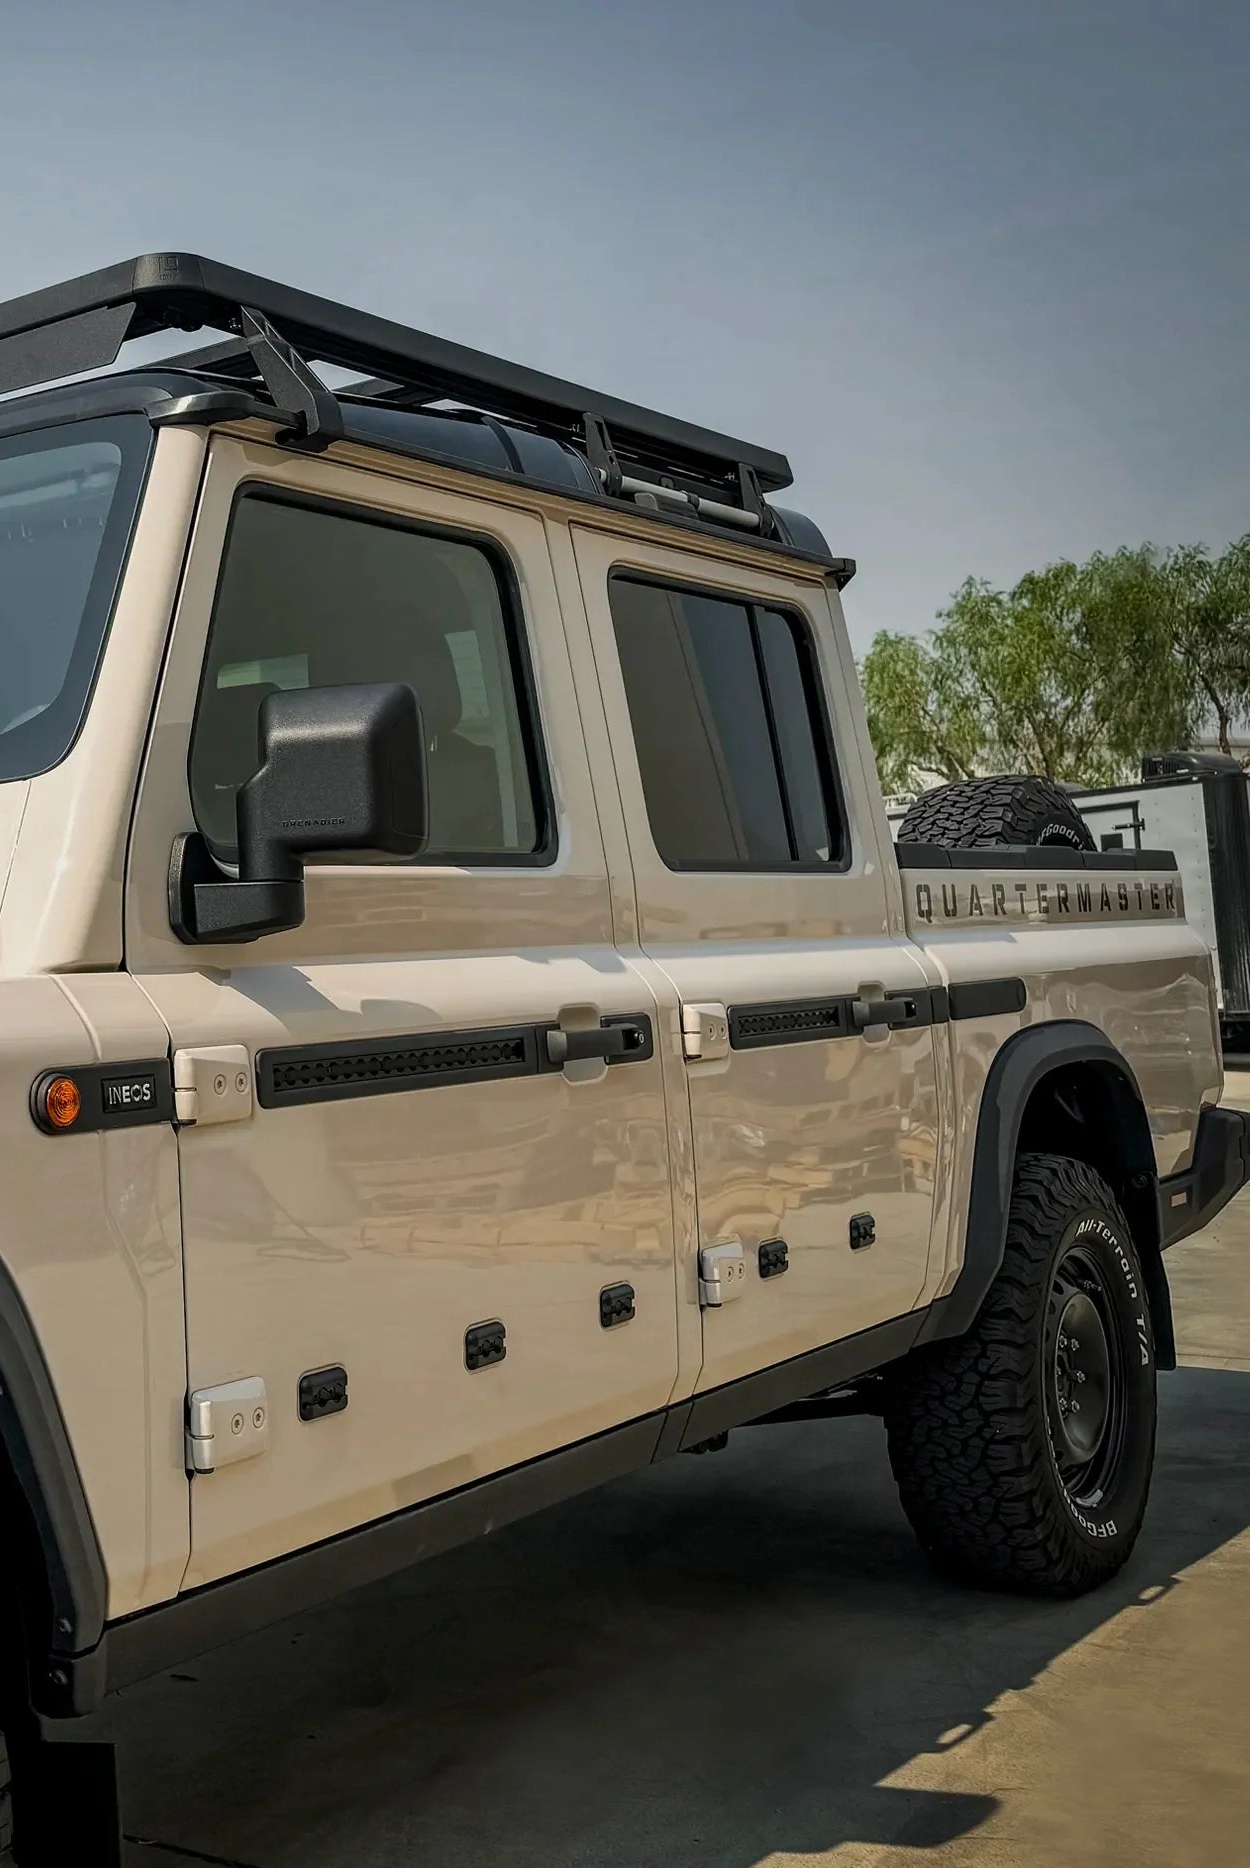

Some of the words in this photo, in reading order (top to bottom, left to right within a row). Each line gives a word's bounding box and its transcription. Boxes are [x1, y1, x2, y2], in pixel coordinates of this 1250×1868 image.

[282, 817, 346, 828] GRENADIER
[916, 882, 1175, 923] QUARTERMASTER
[108, 1083, 151, 1105] INEOS
[1076, 1218, 1137, 1299] All-Terrain
[1137, 1312, 1150, 1366] T/A
